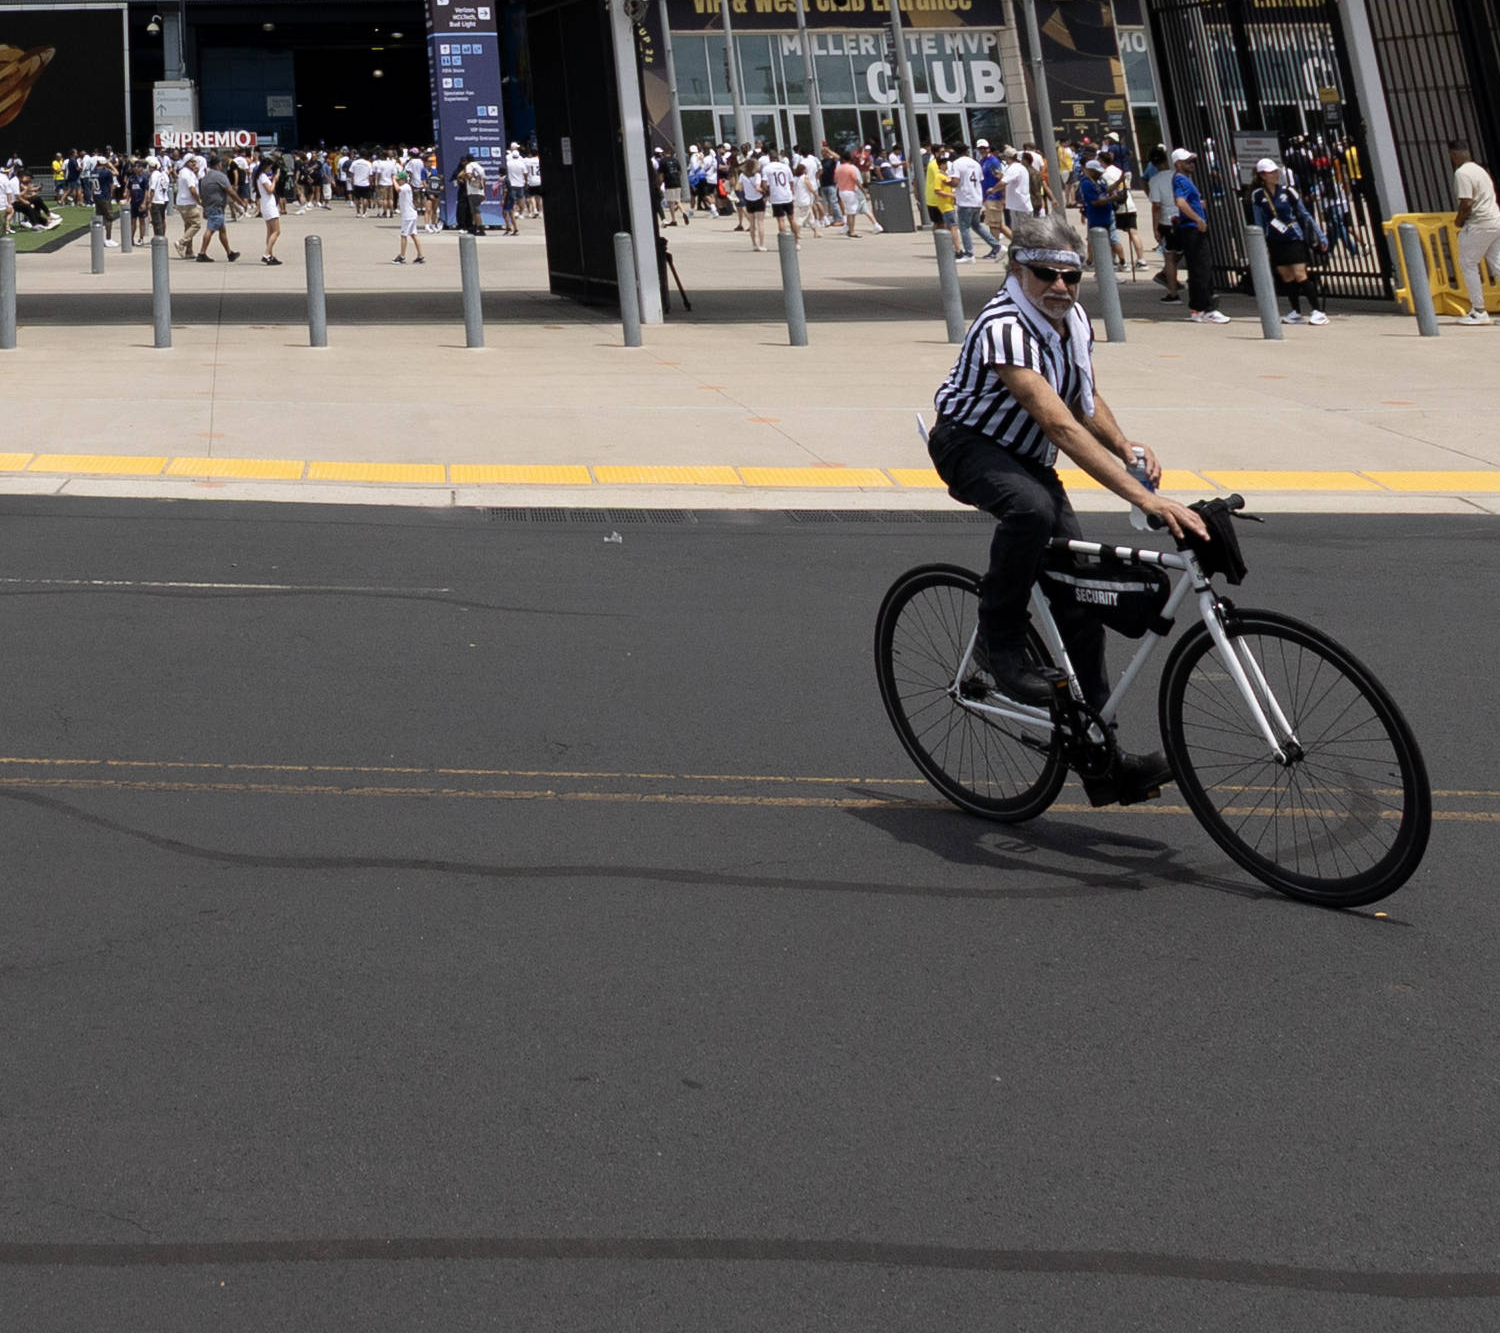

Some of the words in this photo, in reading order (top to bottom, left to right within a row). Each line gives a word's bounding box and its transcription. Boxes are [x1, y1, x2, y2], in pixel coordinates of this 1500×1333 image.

[782, 34, 876, 55] MLLER
[944, 34, 997, 54] MVP
[867, 61, 1005, 103] CLUB
[160, 130, 251, 148] SUPREMIO
[773, 171, 786, 187] 10
[969, 170, 978, 184] 4
[1075, 587, 1118, 606] SECURITY
